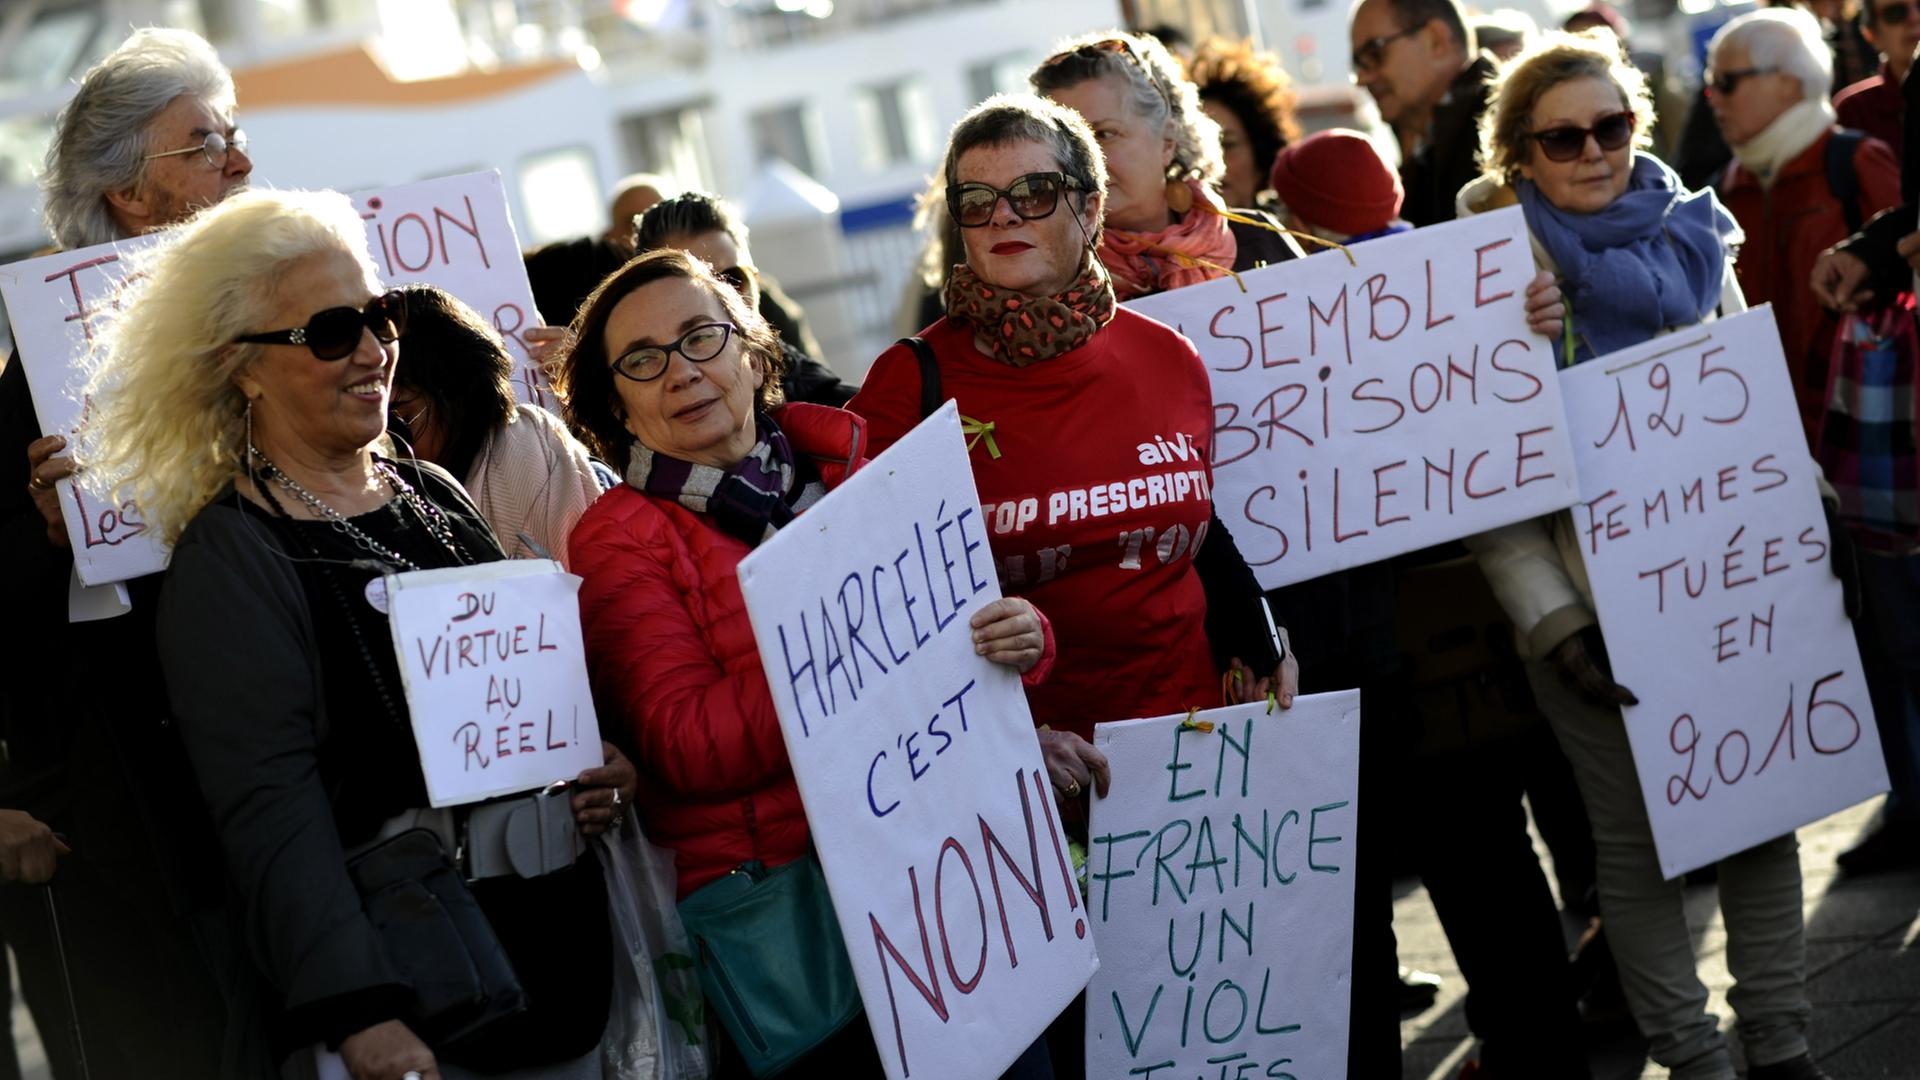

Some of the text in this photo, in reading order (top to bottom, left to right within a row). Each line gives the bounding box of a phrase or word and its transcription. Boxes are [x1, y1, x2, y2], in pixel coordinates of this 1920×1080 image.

[1178, 237, 1516, 373] SEMBLE
[1593, 346, 1750, 452] 125
[980, 469, 1211, 535] TOP PRESCRIPTI
[1584, 453, 1789, 556] FEMMES
[450, 591, 496, 623] DU
[776, 498, 989, 739] HARCELÉE
[1637, 524, 1828, 613] TUÉES
[1711, 603, 1775, 664] EN
[485, 673, 522, 714] AU
[1665, 670, 1862, 806] 2016
[865, 678, 977, 818] C'EST
[1165, 717, 1253, 801] EN
[1092, 799, 1350, 923] FRANCE
[868, 767, 1087, 1079] NON!
[1167, 901, 1254, 978] UN
